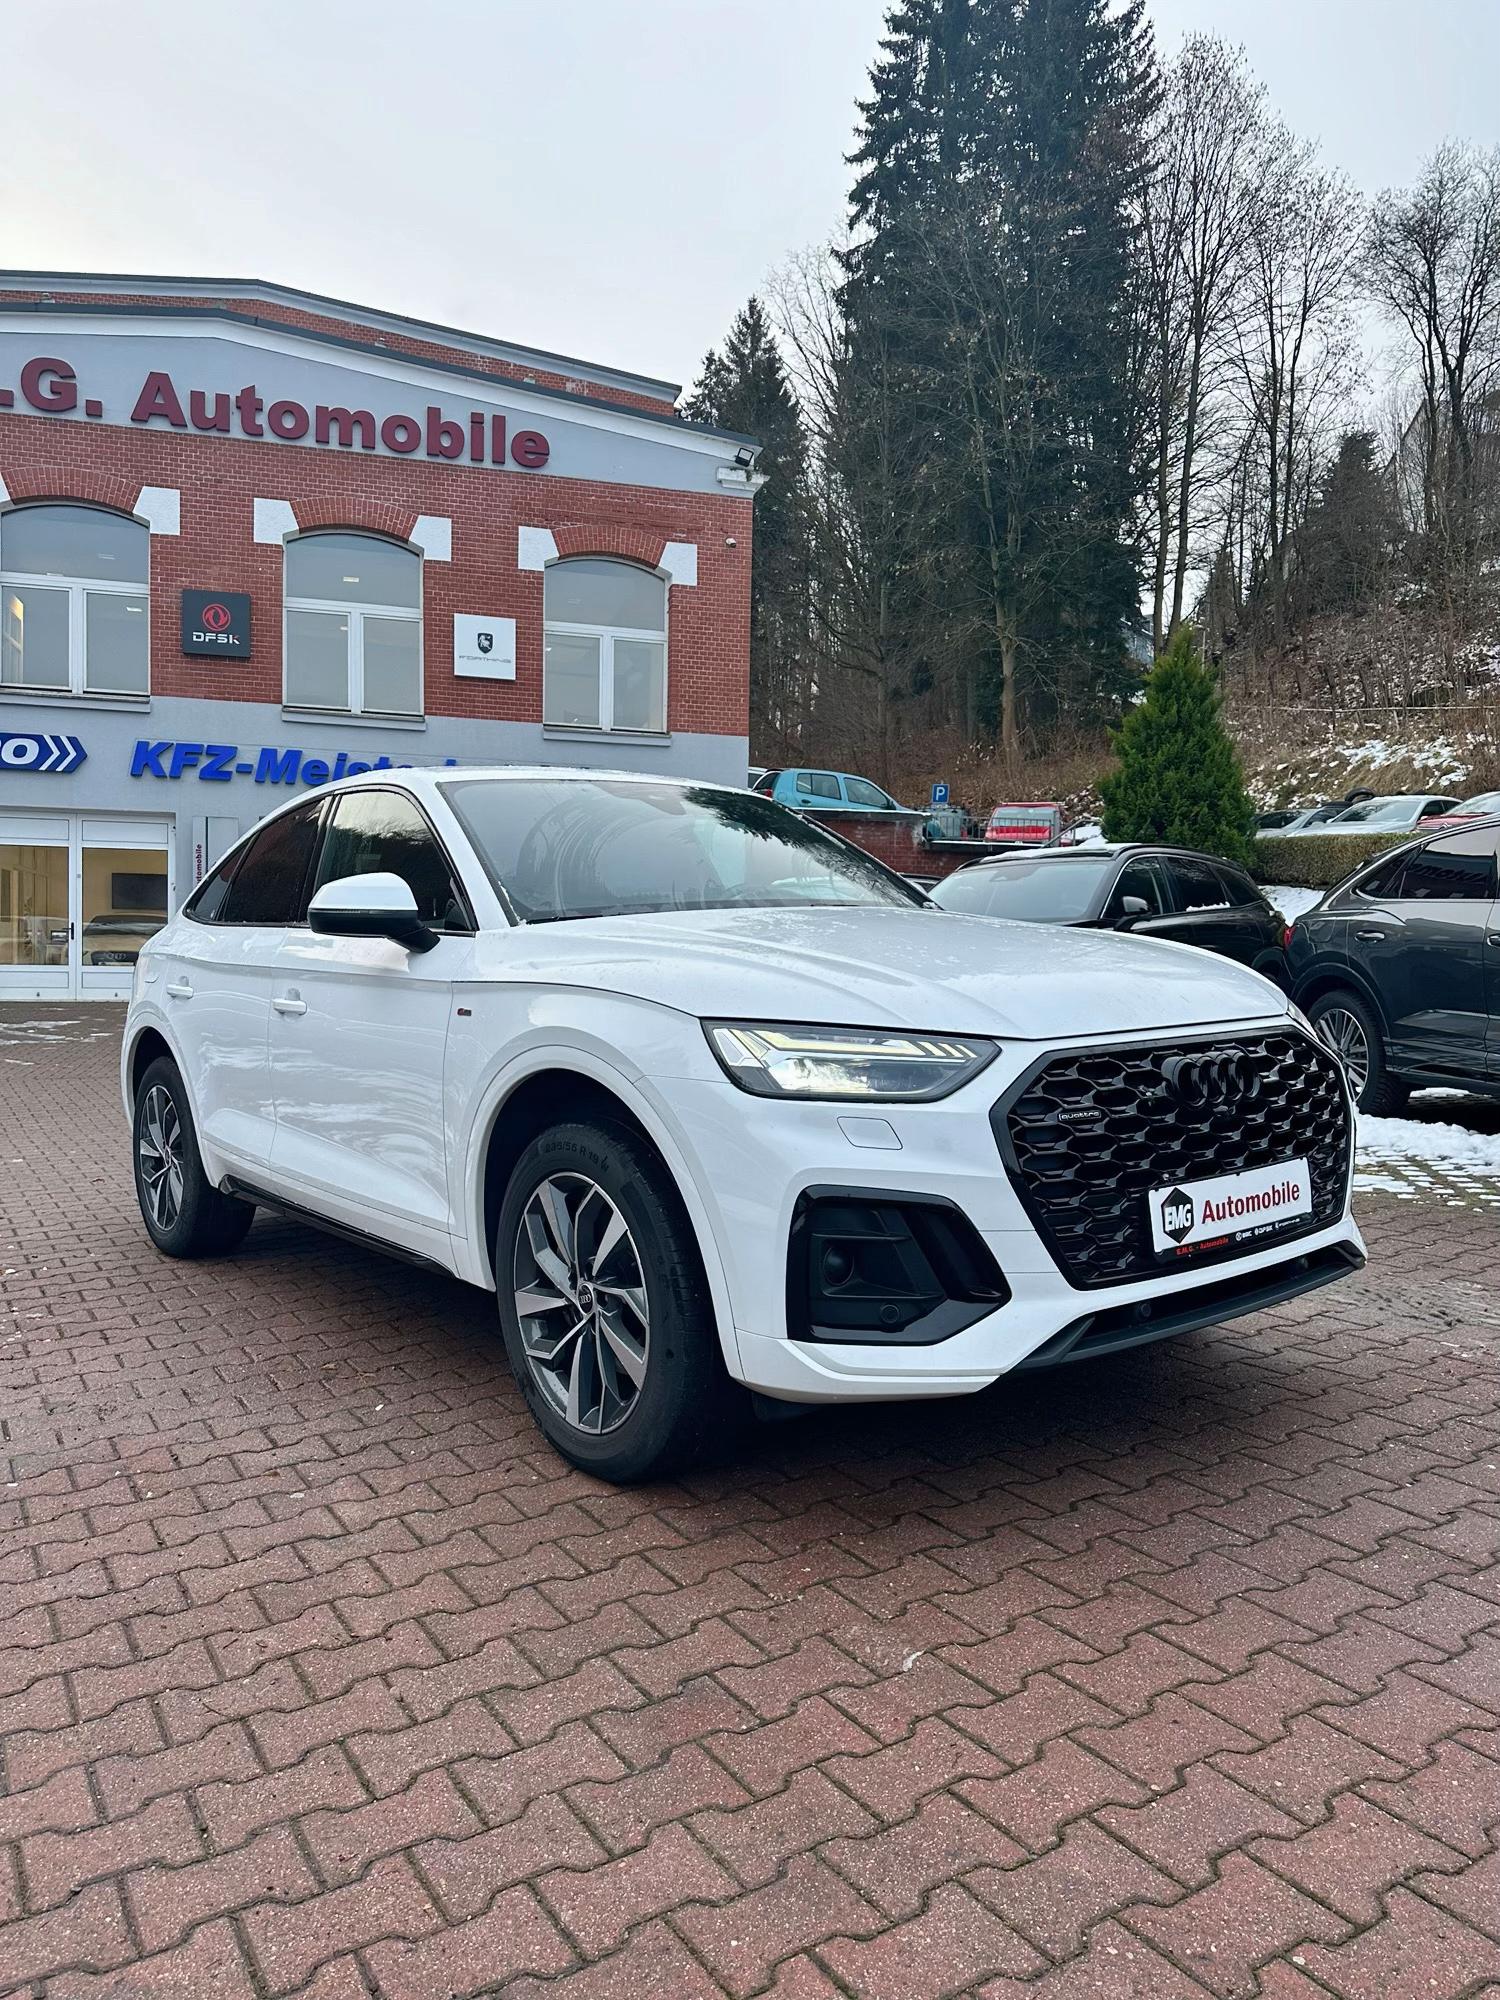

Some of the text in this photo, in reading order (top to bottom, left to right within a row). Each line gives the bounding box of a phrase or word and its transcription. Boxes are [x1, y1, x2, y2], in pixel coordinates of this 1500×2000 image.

[130, 371, 550, 468] Automobile
[192, 632, 240, 645] DFSK
[935, 786, 946, 801] P
[1201, 1180, 1301, 1225] Automobile
[1164, 1203, 1193, 1233] EMG
